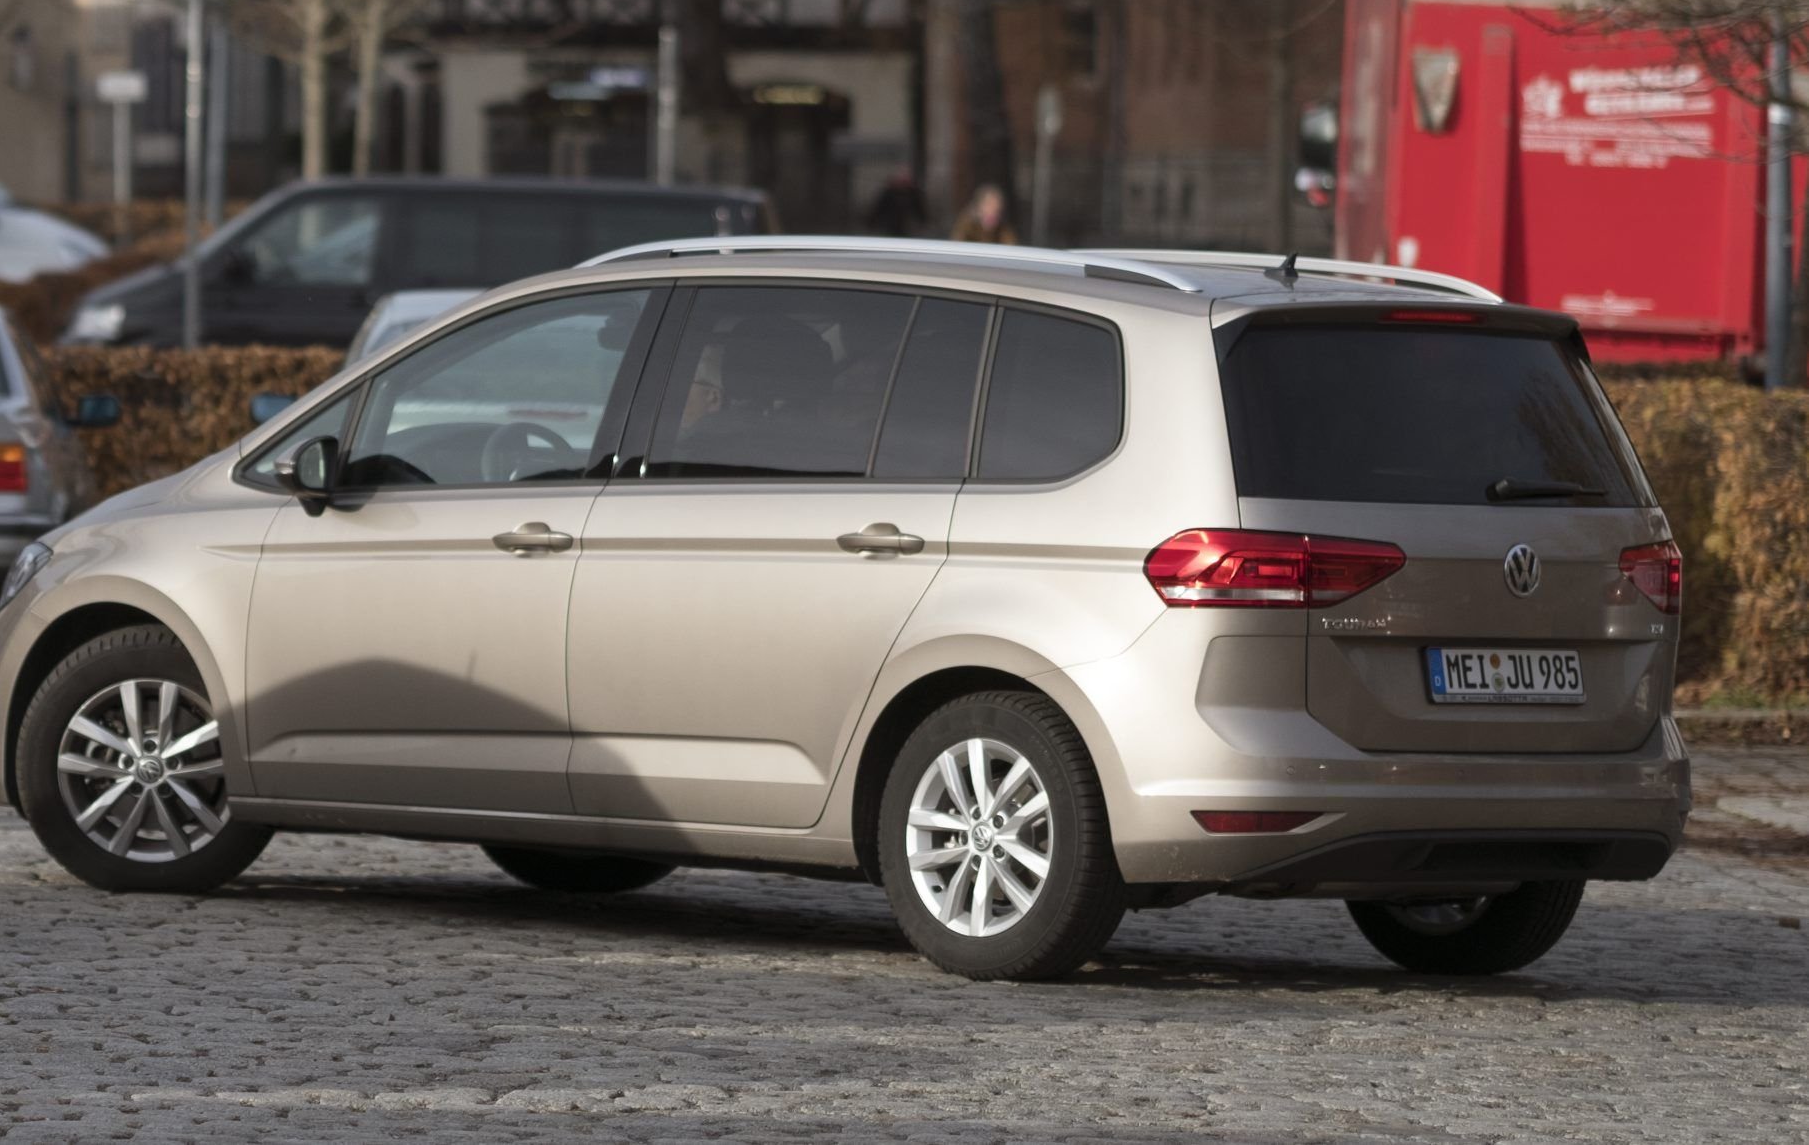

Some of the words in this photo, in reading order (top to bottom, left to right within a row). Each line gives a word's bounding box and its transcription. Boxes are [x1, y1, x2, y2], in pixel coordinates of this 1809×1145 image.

[1445, 654, 1490, 690] MEI
[1506, 655, 1535, 690] JU
[1539, 655, 1580, 690] 985
